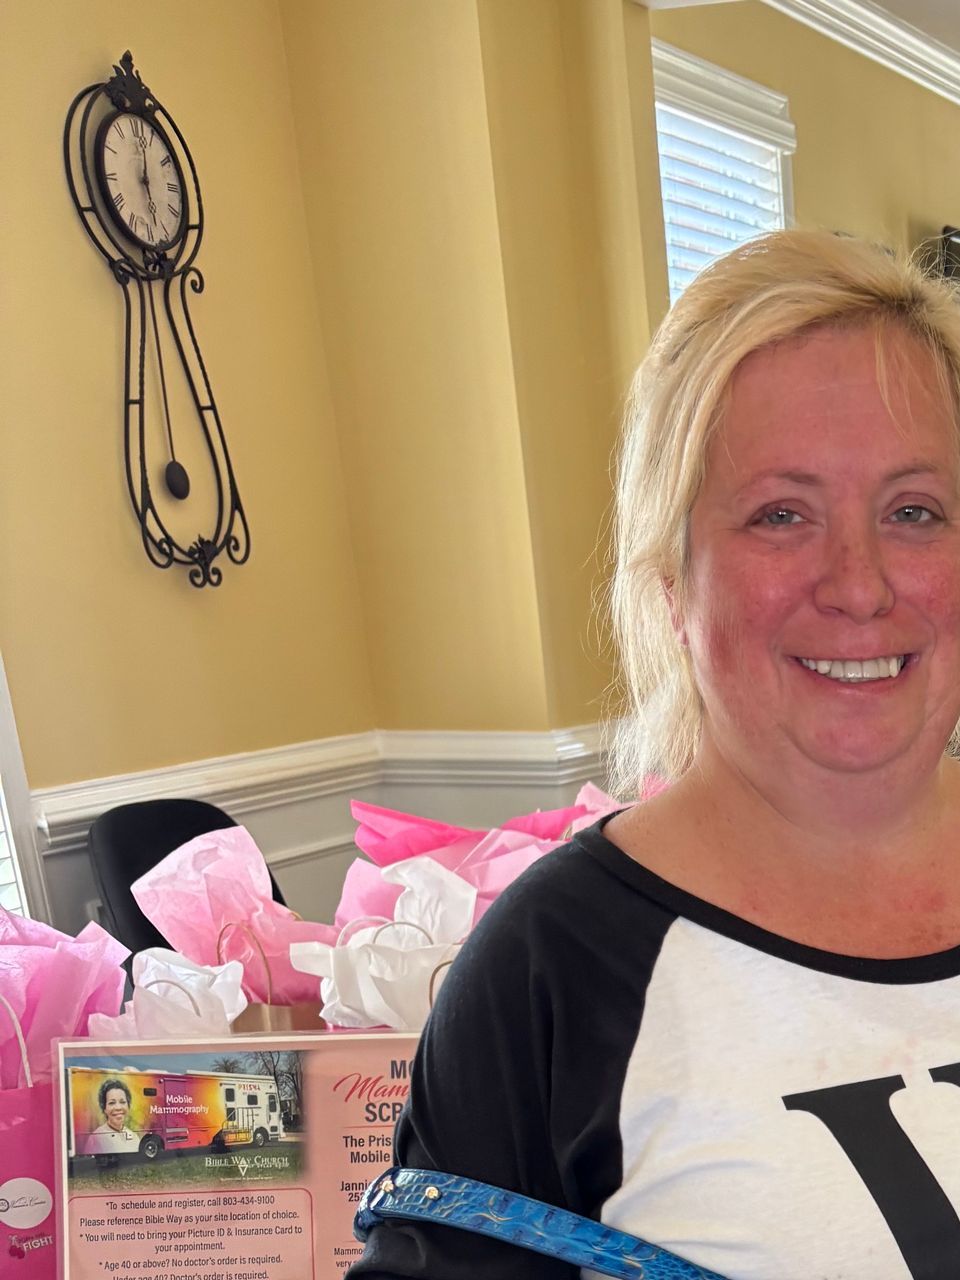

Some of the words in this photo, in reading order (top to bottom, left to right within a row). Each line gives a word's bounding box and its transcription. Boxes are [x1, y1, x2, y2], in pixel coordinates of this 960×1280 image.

[166, 1094, 193, 1105] Mobile
[149, 1104, 209, 1115] Mammography
[342, 1135, 365, 1147] The
[350, 1150, 391, 1163] Mobile
[120, 1199, 157, 1210] schedule
[157, 1199, 173, 1209] and
[174, 1197, 206, 1209] register,
[207, 1197, 221, 1207] call
[222, 1195, 275, 1206] 803-434-9100
[80, 1217, 105, 1227] Please
[106, 1216, 144, 1226] reference
[145, 1214, 165, 1225] Bible
[166, 1214, 183, 1225] Way
[184, 1215, 194, 1223] as
[195, 1214, 213, 1224] your
[213, 1212, 229, 1221] site
[229, 1210, 261, 1221] location
[262, 1211, 271, 1220] of
[271, 1209, 300, 1220] choice.
[85, 1232, 99, 1242] You
[100, 1232, 115, 1241] will
[116, 1231, 136, 1241] need
[137, 1232, 146, 1240] to
[146, 1230, 167, 1241] bring
[168, 1231, 186, 1241] your
[187, 1228, 215, 1238] Picture
[217, 1227, 225, 1237] ID
[226, 1227, 234, 1237] &
[235, 1226, 273, 1237] Insurance
[274, 1225, 293, 1235] Card
[294, 1225, 303, 1235] to
[23, 1235, 53, 1251] FIGHT
[154, 1244, 173, 1254] your
[173, 1241, 225, 1253] appointment.
[104, 1261, 120, 1271] Age
[120, 1260, 131, 1269] 40
[132, 1261, 141, 1269] or
[142, 1258, 170, 1268] above?
[171, 1258, 183, 1267] No
[184, 1257, 216, 1267] doctor's
[217, 1255, 238, 1266] order
[239, 1255, 247, 1265] is
[248, 1254, 283, 1266] required.
[203, 1271, 224, 1280] order
[226, 1271, 233, 1280] is
[234, 1270, 269, 1280] required.
